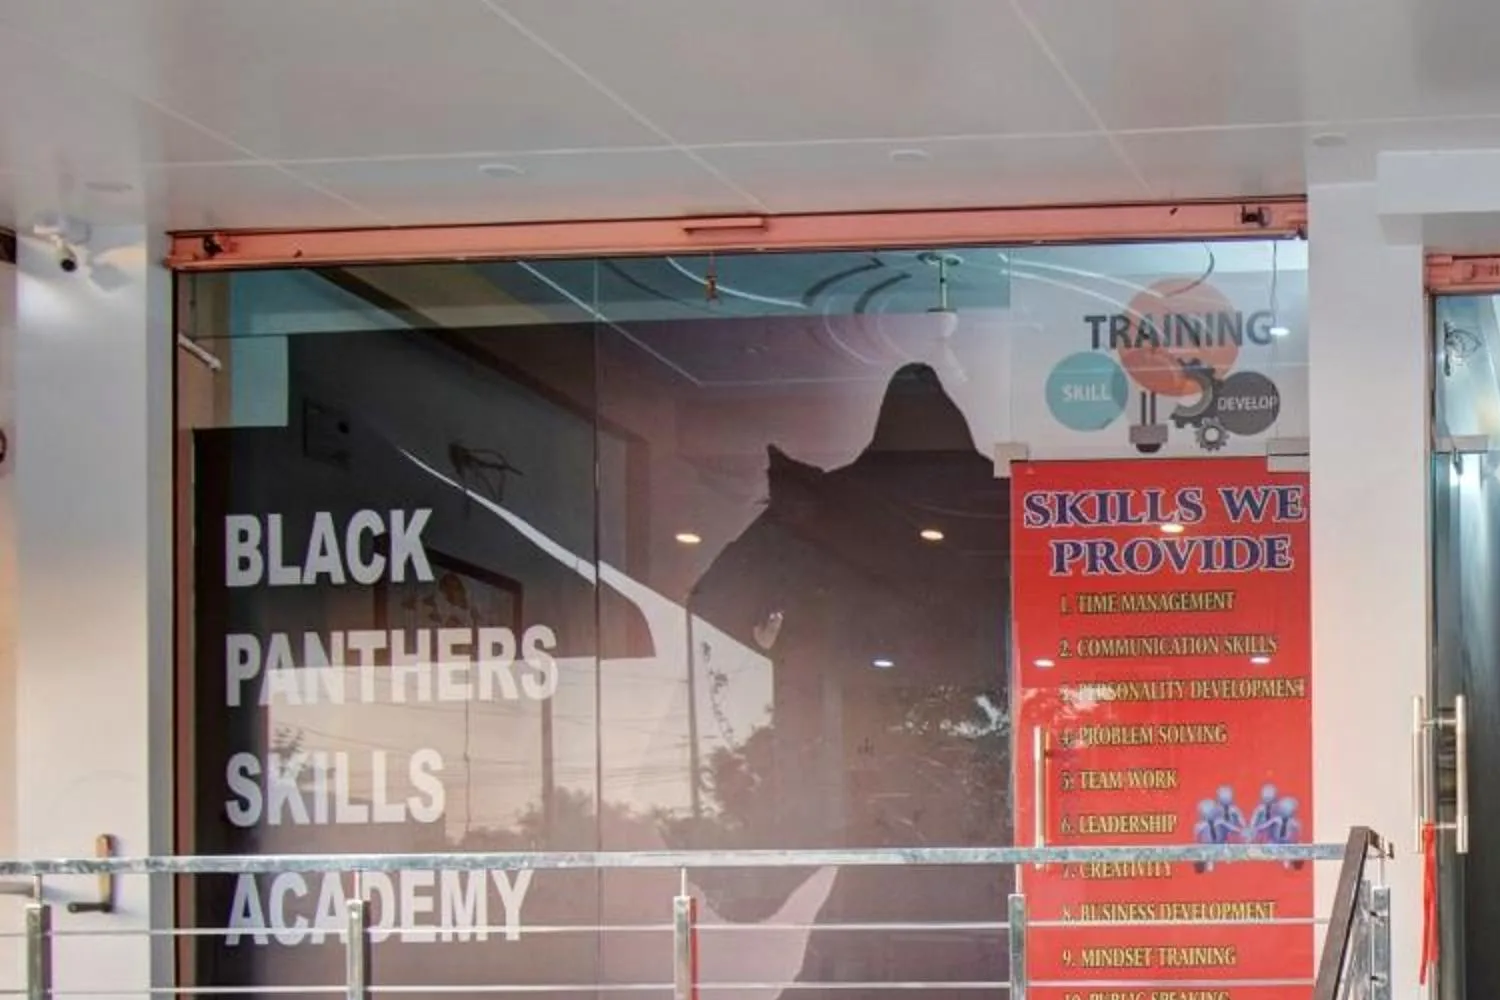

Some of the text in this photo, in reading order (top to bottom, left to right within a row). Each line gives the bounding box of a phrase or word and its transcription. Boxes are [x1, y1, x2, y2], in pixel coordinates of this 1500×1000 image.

[1084, 310, 1275, 349] TRAINING
[1061, 382, 1111, 401] SKILL
[1218, 395, 1278, 412] DEVELOP
[1024, 487, 1305, 527] SKILLS WE
[225, 508, 433, 587] BLACK
[1050, 536, 1293, 576] PROVIDE
[1077, 592, 1119, 614] TIME
[1120, 590, 1235, 613] MANAGEMENT
[1077, 635, 1221, 658] COMMUNICATION
[1224, 634, 1278, 655] SKILLS
[226, 625, 558, 706] PANTHERS
[1078, 681, 1187, 702] PERSONALITY
[1190, 678, 1305, 700] DEVELOPMENT
[1079, 725, 1154, 746] PROBLEM
[1157, 723, 1228, 743] SOLVING
[225, 748, 445, 827] SKILLS
[1079, 771, 1123, 790] TEAM
[1126, 769, 1178, 789] WORK
[1079, 815, 1178, 835] LEADERSHIP
[1079, 860, 1173, 879] CREATIVITY
[225, 870, 534, 947] ACADEMY
[1080, 902, 1156, 921] BUSINESS
[1159, 900, 1277, 921] DEVELOPMENT
[1081, 948, 1154, 968] MINDSET
[1158, 946, 1236, 966] TRAINING
